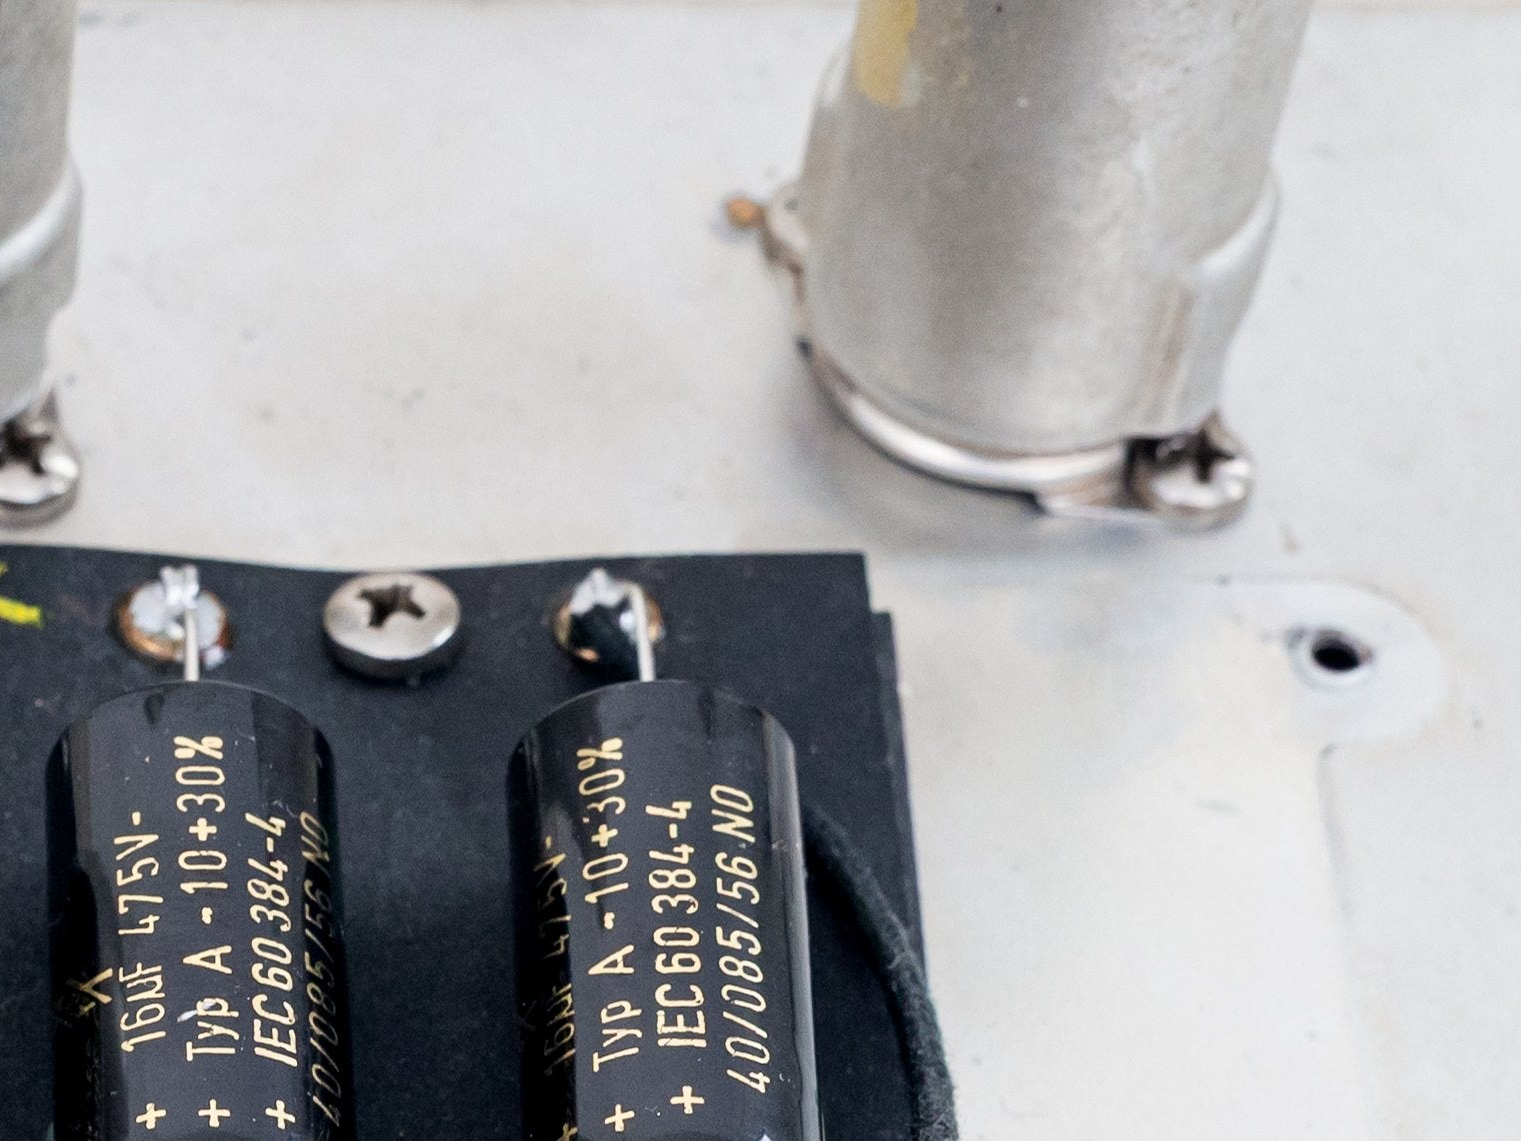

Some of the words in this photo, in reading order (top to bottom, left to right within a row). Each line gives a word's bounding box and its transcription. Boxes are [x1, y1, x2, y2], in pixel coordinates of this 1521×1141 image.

[183, 946, 232, 974] A
[588, 945, 634, 975] A
[716, 852, 770, 1093] 40/085/56
[187, 997, 239, 1062] Typ
[593, 1000, 643, 1072] Typ
